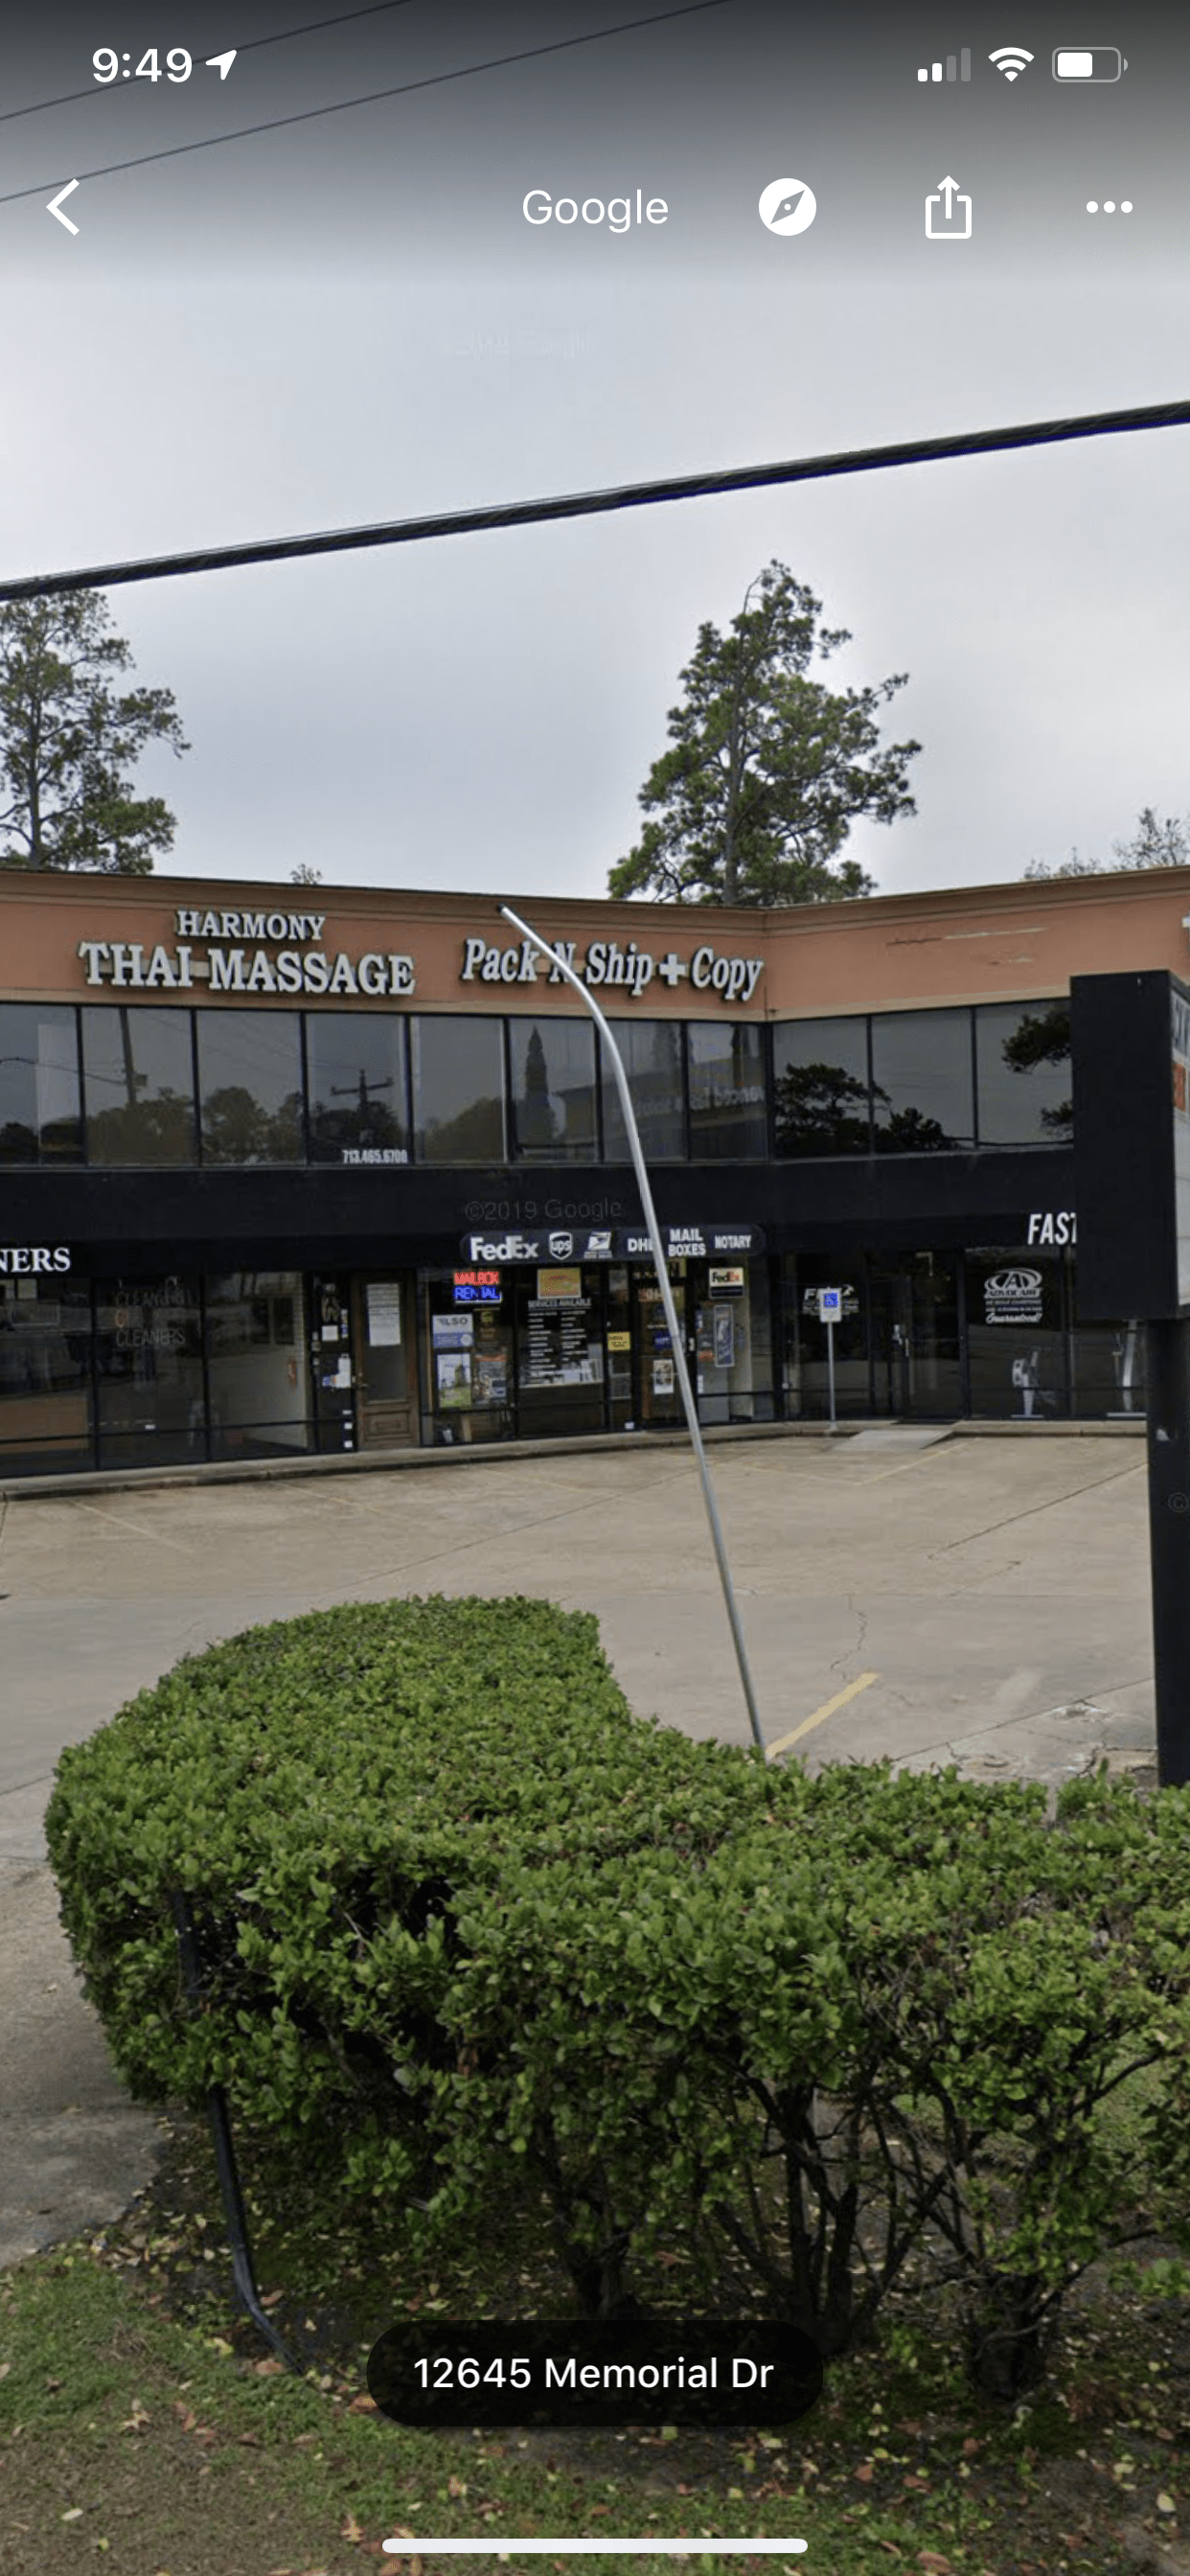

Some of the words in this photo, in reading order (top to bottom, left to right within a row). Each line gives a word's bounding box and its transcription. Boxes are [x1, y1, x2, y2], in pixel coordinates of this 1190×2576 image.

[177, 909, 325, 940] HARMONY
[79, 942, 193, 986] THAI
[208, 948, 416, 994] MASSAGE
[462, 938, 539, 981] Pack
[550, 942, 577, 982] N
[586, 942, 654, 996] Ship
[692, 947, 763, 1000] Copy
[670, 1228, 703, 1242] MAIL
[1027, 1211, 1077, 1245] FAST
[470, 1235, 538, 1261] FedEx
[668, 1243, 706, 1256] BOXES
[715, 1234, 752, 1249] NOTARY
[712, 1270, 741, 1284] FedEx
